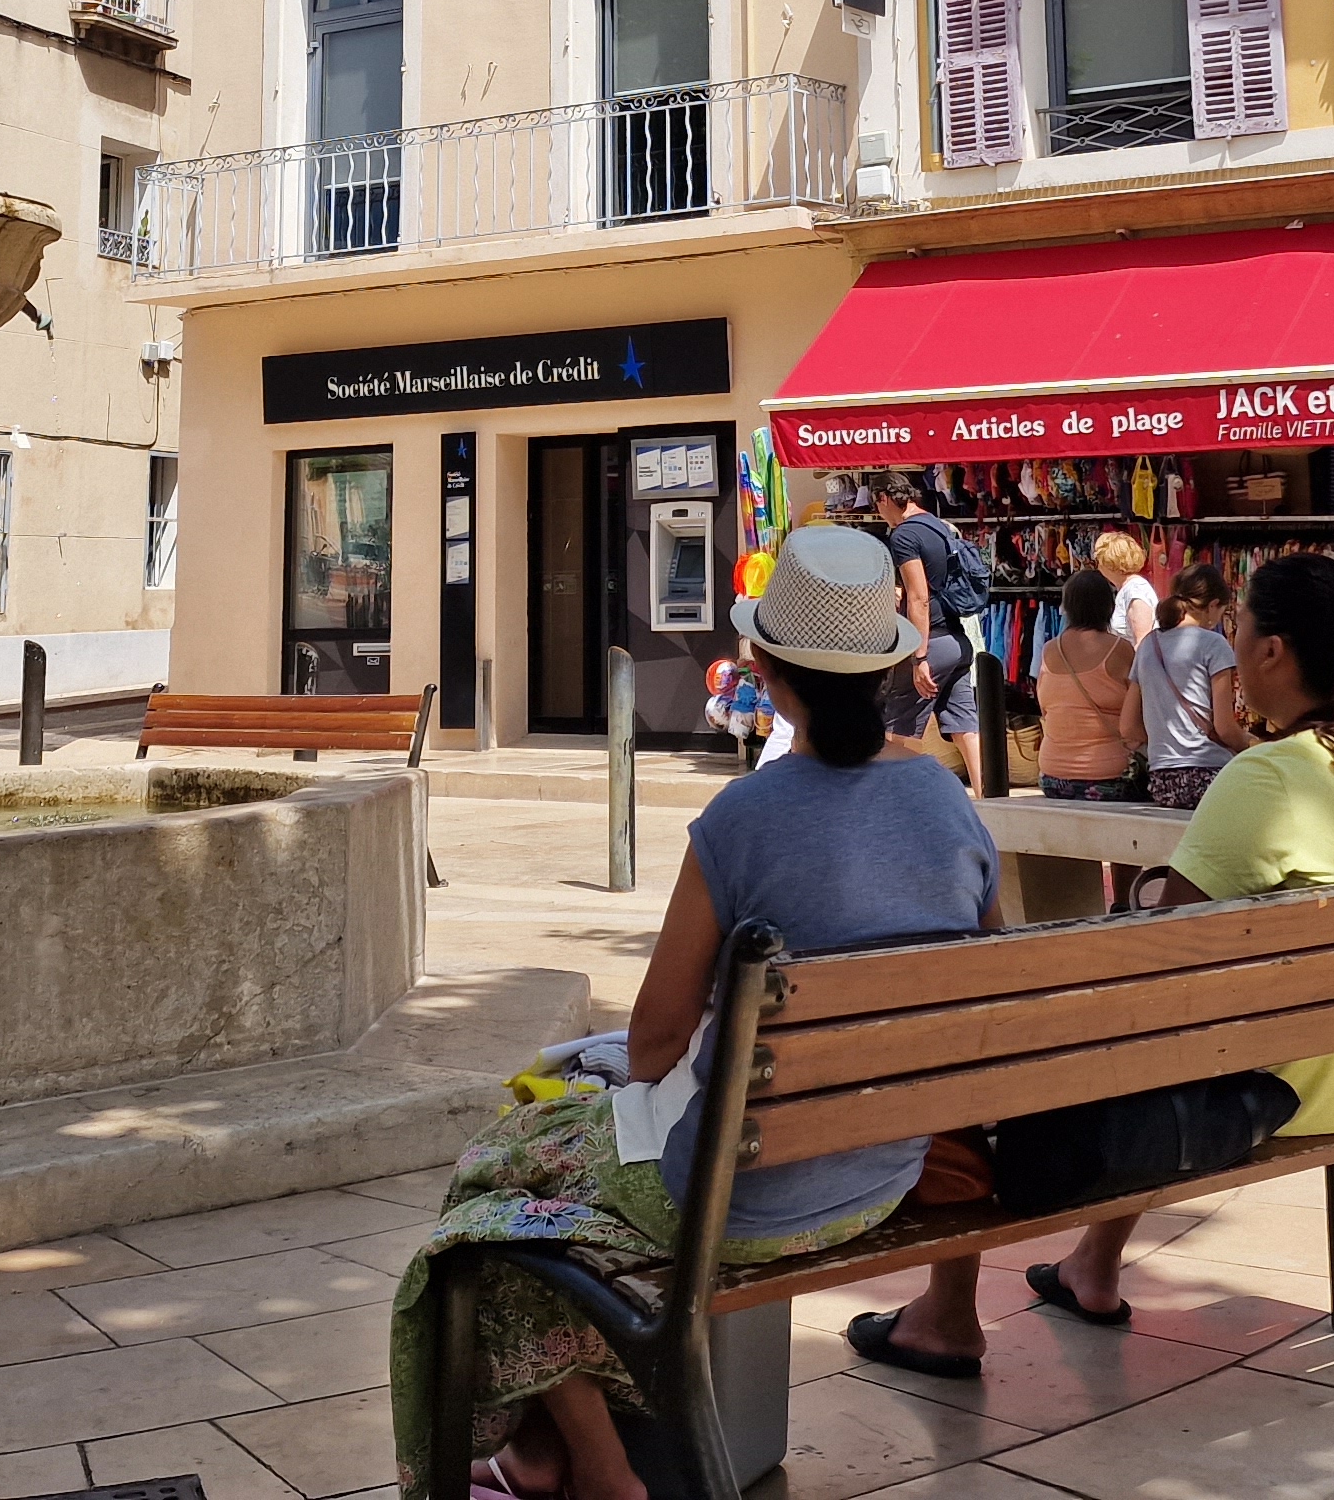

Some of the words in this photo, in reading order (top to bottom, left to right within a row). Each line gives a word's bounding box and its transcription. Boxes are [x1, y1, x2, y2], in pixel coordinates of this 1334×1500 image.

[327, 372, 391, 400] Société
[394, 366, 506, 395] Marseillaise
[509, 361, 534, 386] de
[536, 356, 601, 384] Crédit
[1216, 384, 1301, 419] JACK
[797, 422, 912, 448] Souvenirs
[951, 413, 1046, 441] Articles
[1061, 410, 1095, 436] de
[1111, 407, 1185, 438] plage
[1217, 420, 1283, 442] Famille
